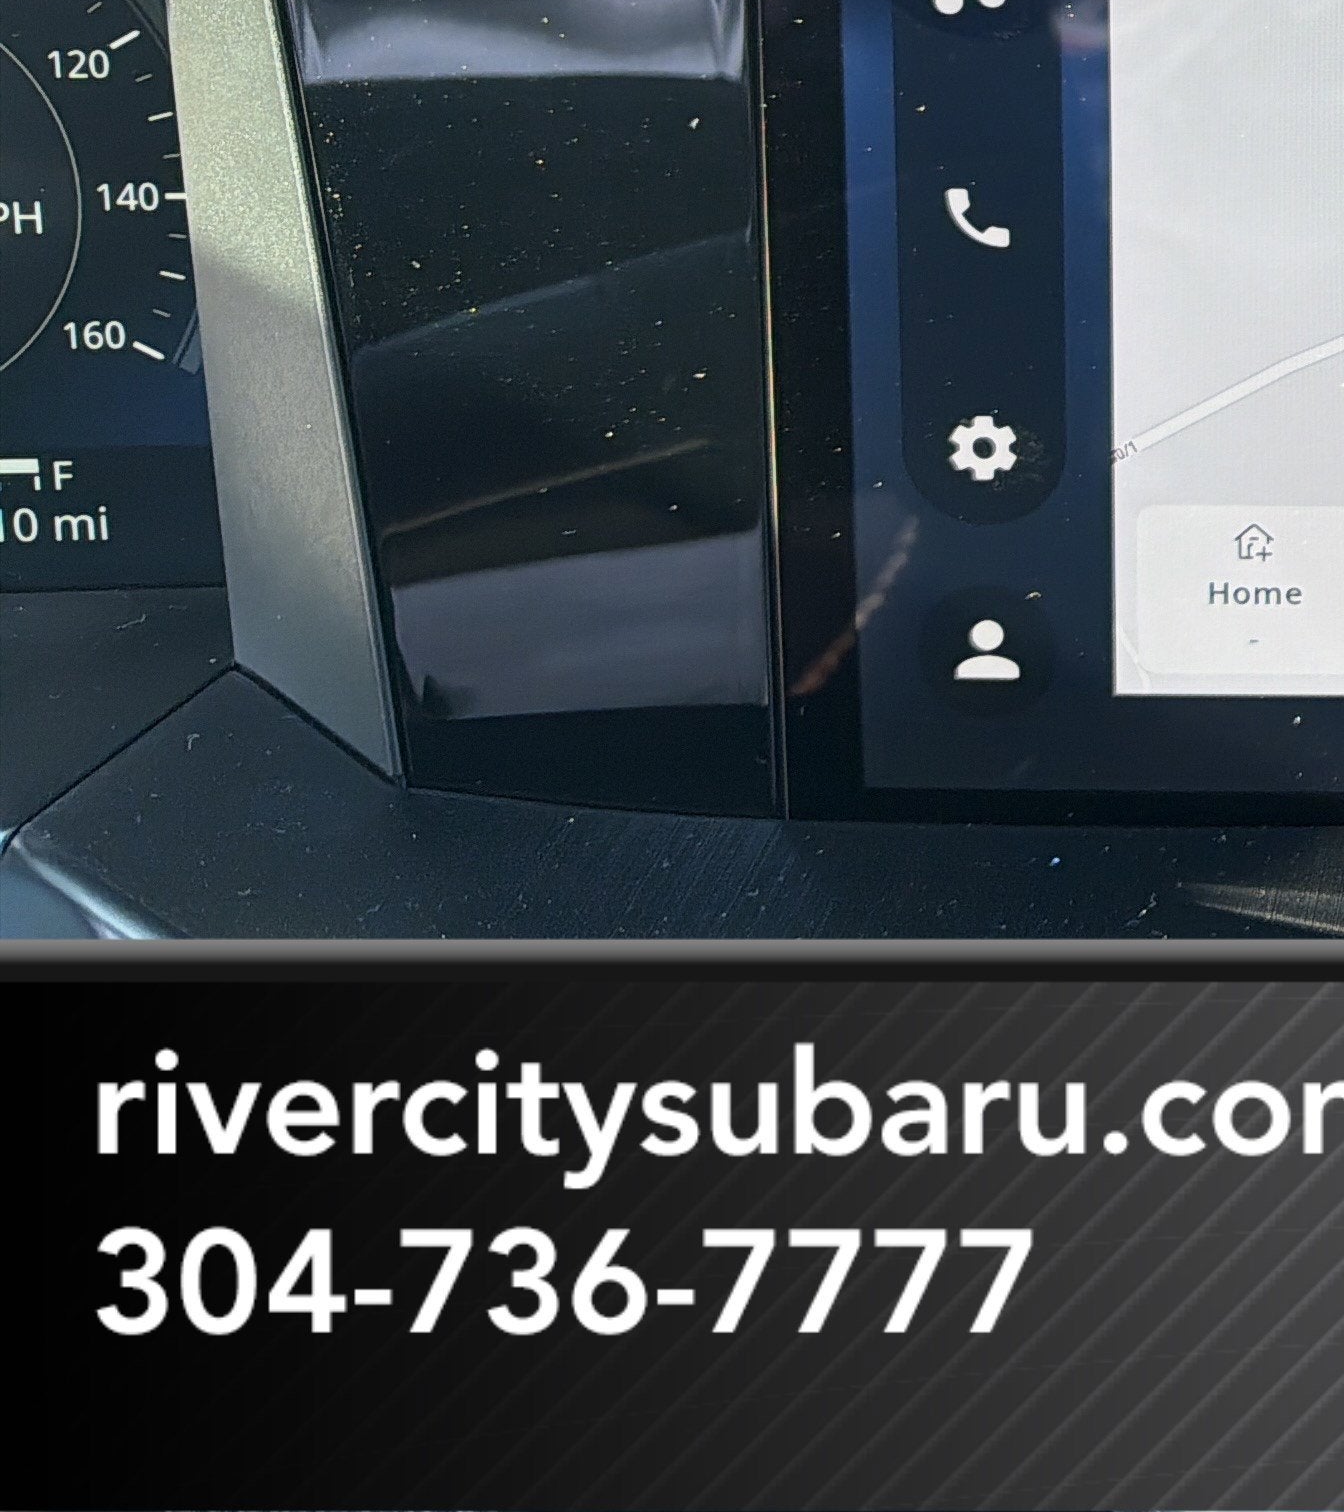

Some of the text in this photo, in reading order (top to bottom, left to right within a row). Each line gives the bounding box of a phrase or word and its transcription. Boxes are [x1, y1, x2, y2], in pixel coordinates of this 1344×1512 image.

[47, 49, 110, 79] 120
[97, 181, 159, 212] 140
[64, 320, 126, 350] 160
[53, 460, 74, 491] F
[54, 505, 109, 542] mi
[1209, 581, 1303, 606] Home
